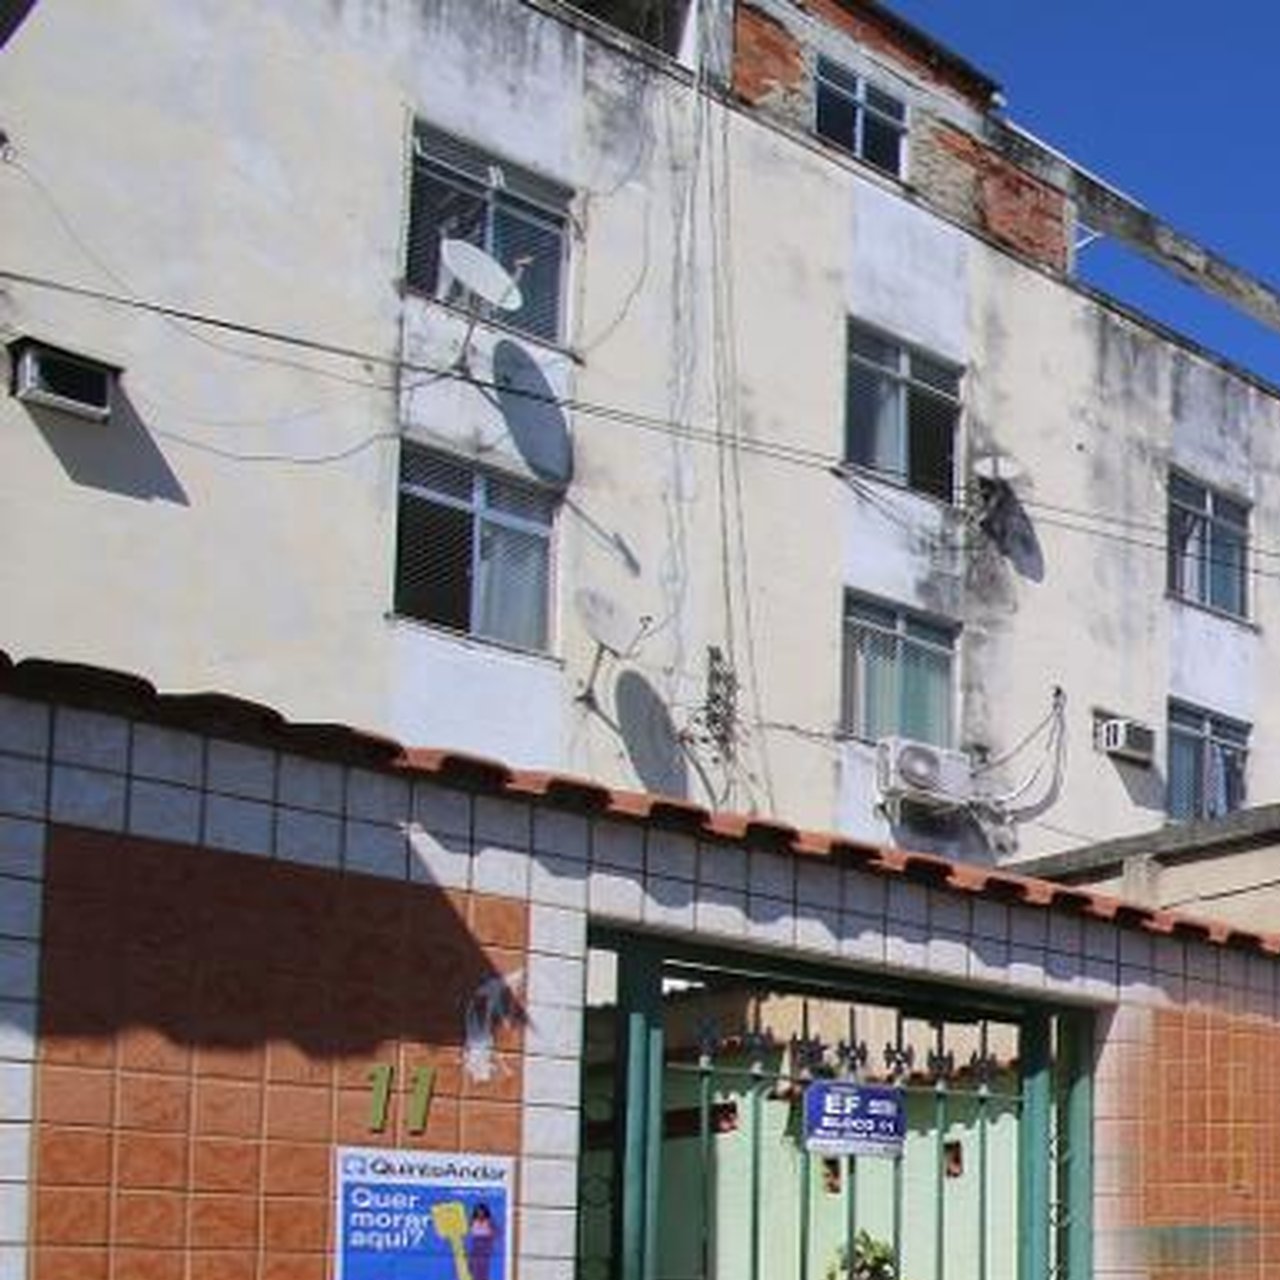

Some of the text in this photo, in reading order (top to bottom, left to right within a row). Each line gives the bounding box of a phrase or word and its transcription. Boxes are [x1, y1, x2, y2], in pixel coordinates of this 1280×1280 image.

[369, 1065, 436, 1135] 11
[351, 1187, 421, 1210] Quer
[351, 1211, 431, 1230] morar
[350, 1230, 425, 1250] aqui?
